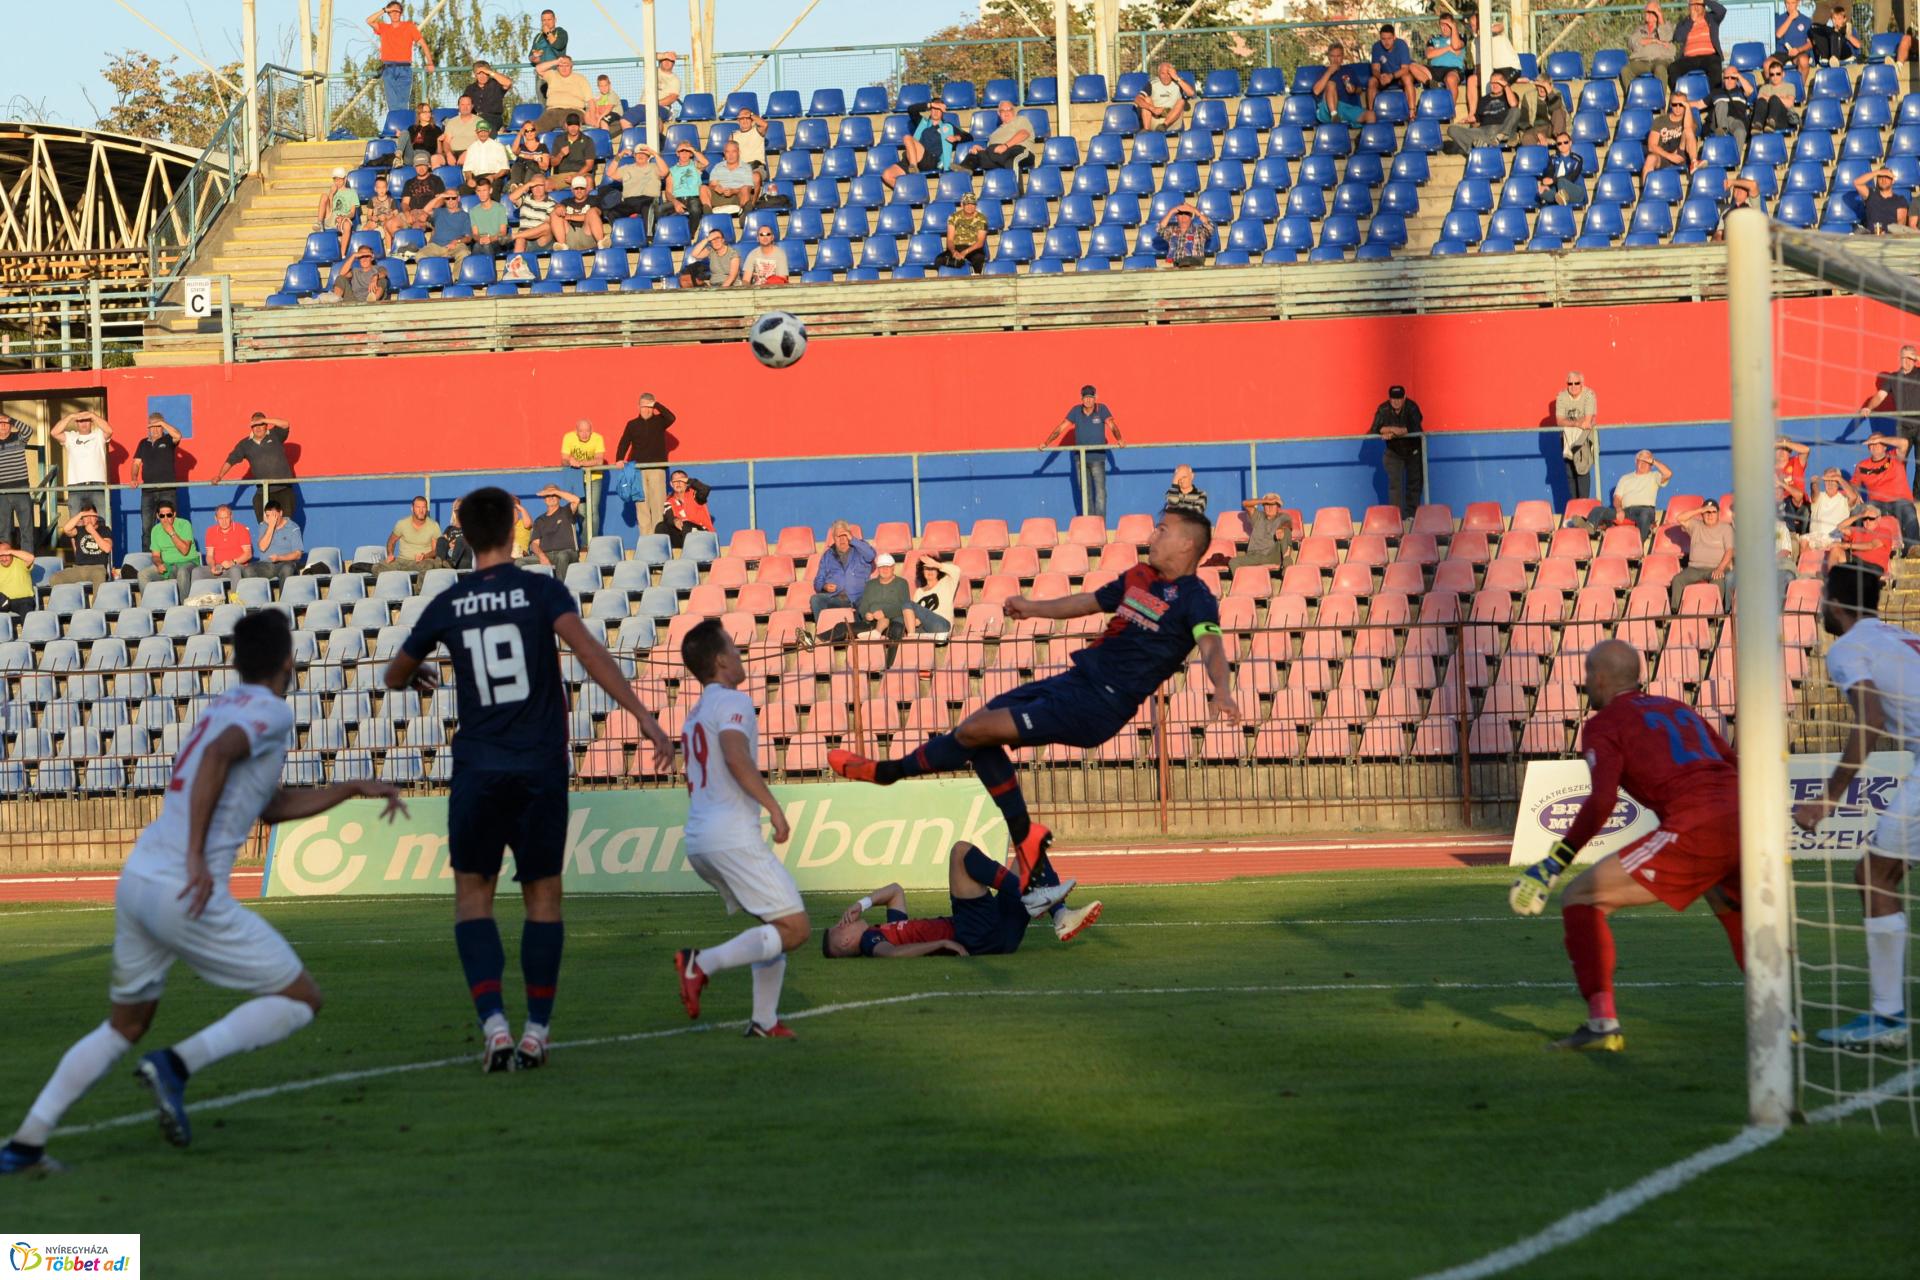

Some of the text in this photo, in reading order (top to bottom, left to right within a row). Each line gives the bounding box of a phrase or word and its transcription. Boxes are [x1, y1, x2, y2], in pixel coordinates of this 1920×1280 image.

[191, 294, 205, 313] C
[451, 588, 530, 618] TÓTH B.
[462, 623, 530, 707] 19
